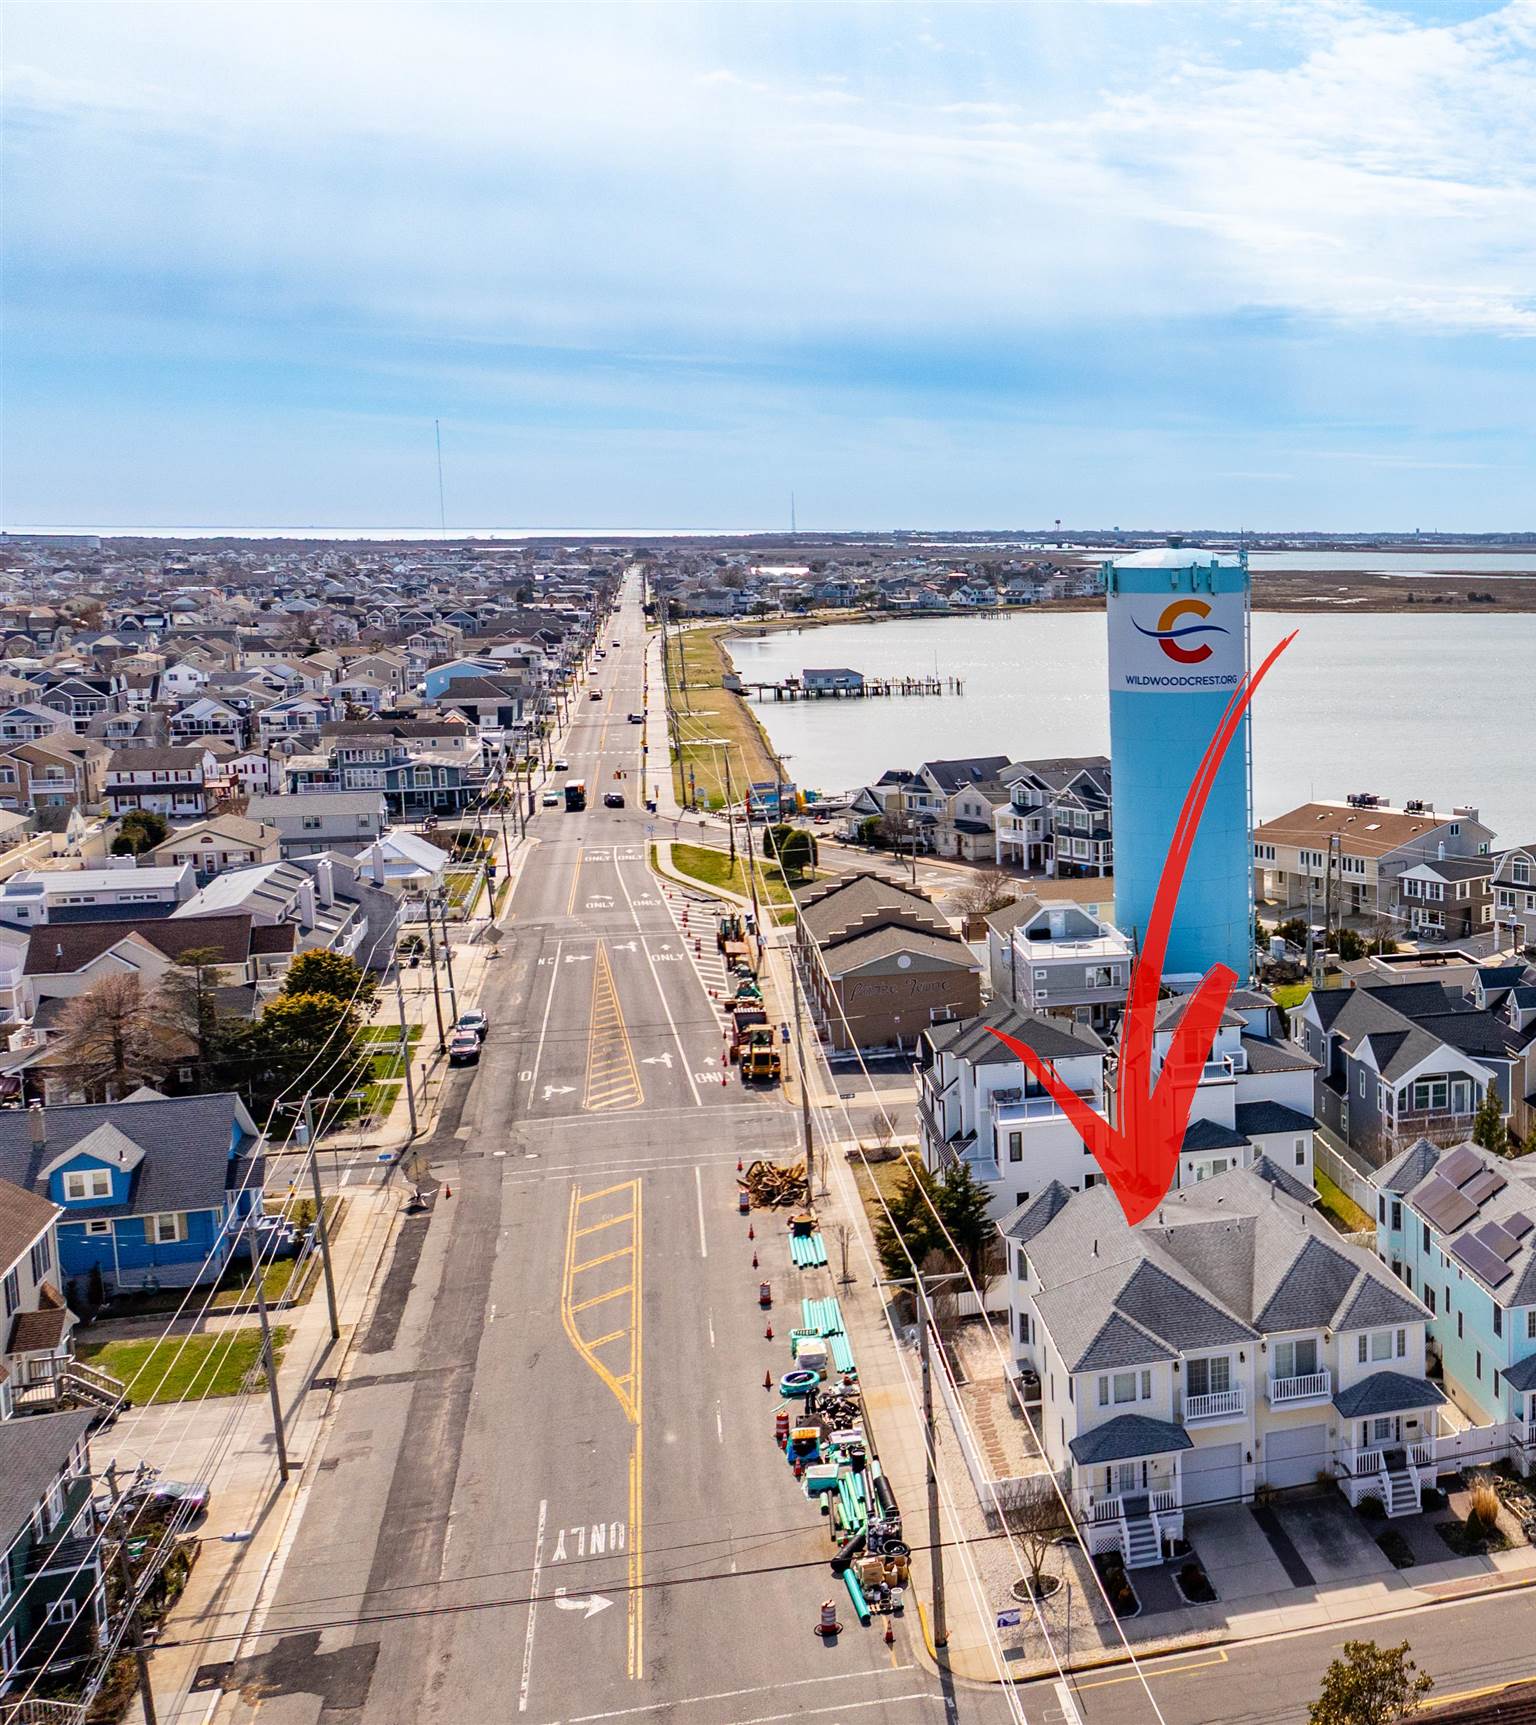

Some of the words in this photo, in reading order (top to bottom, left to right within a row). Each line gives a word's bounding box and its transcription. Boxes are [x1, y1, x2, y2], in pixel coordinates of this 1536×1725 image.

[1126, 675, 1237, 686] WILDWOODCREST.ORG
[585, 901, 615, 909] ONLY
[633, 899, 662, 907] ONLY
[651, 953, 684, 962] ONLY
[694, 1071, 736, 1083] ONLY
